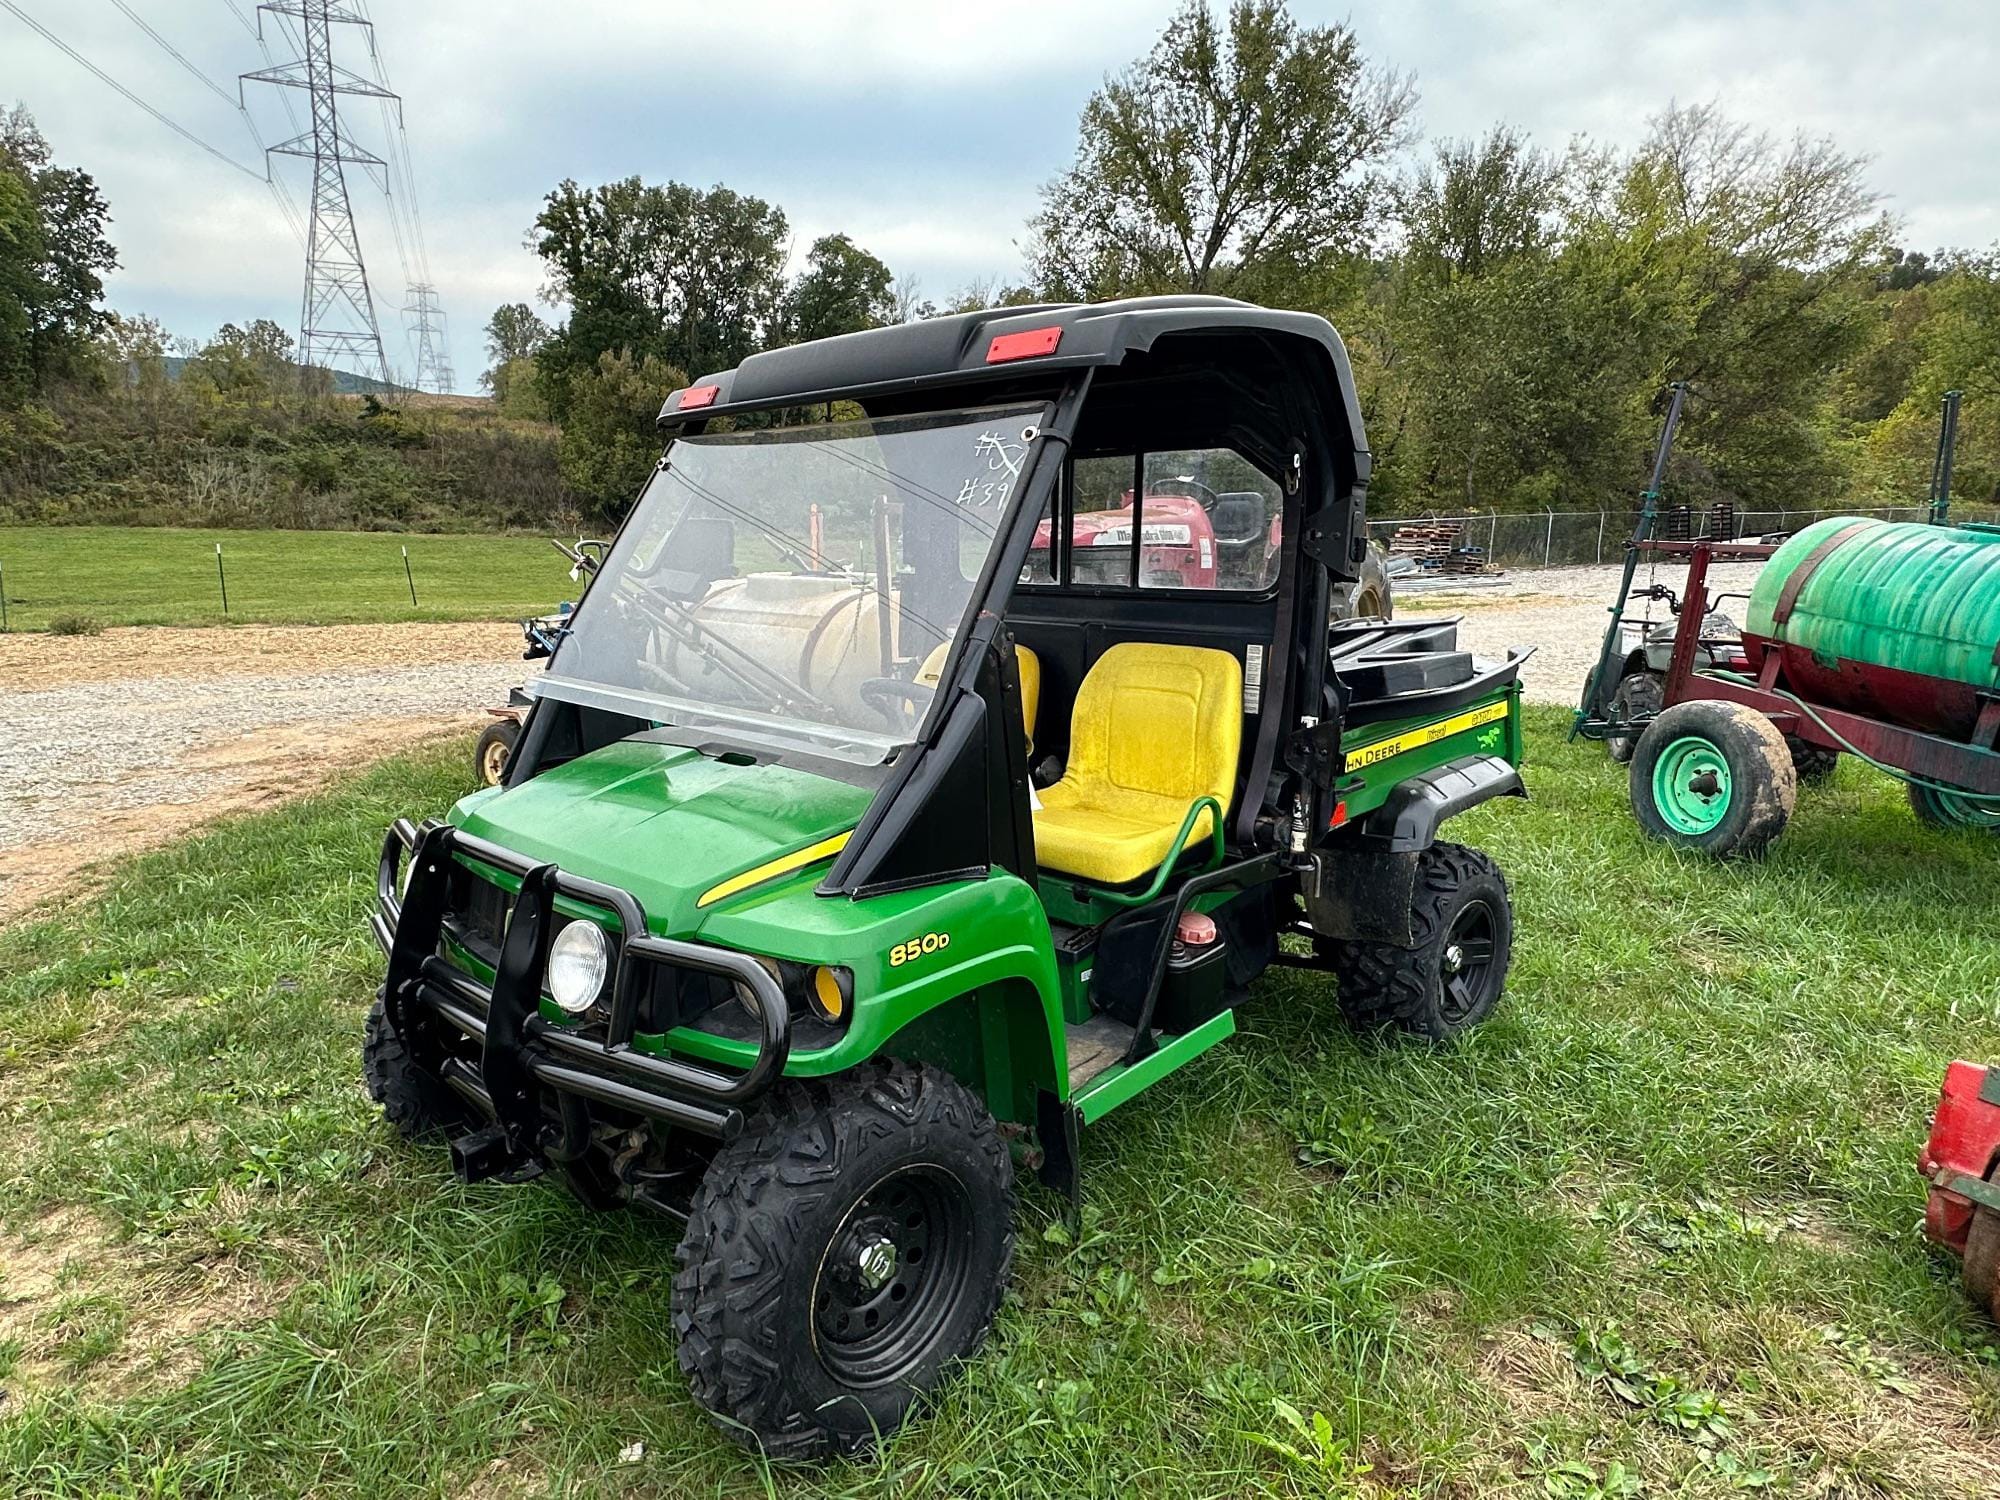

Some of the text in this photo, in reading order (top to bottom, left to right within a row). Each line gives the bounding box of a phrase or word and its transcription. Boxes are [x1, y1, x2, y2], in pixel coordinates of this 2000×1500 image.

[955, 477, 1009, 511] #39
[1346, 756, 1363, 770] HN
[1365, 742, 1402, 764] DEERE
[889, 932, 950, 967] 850D
